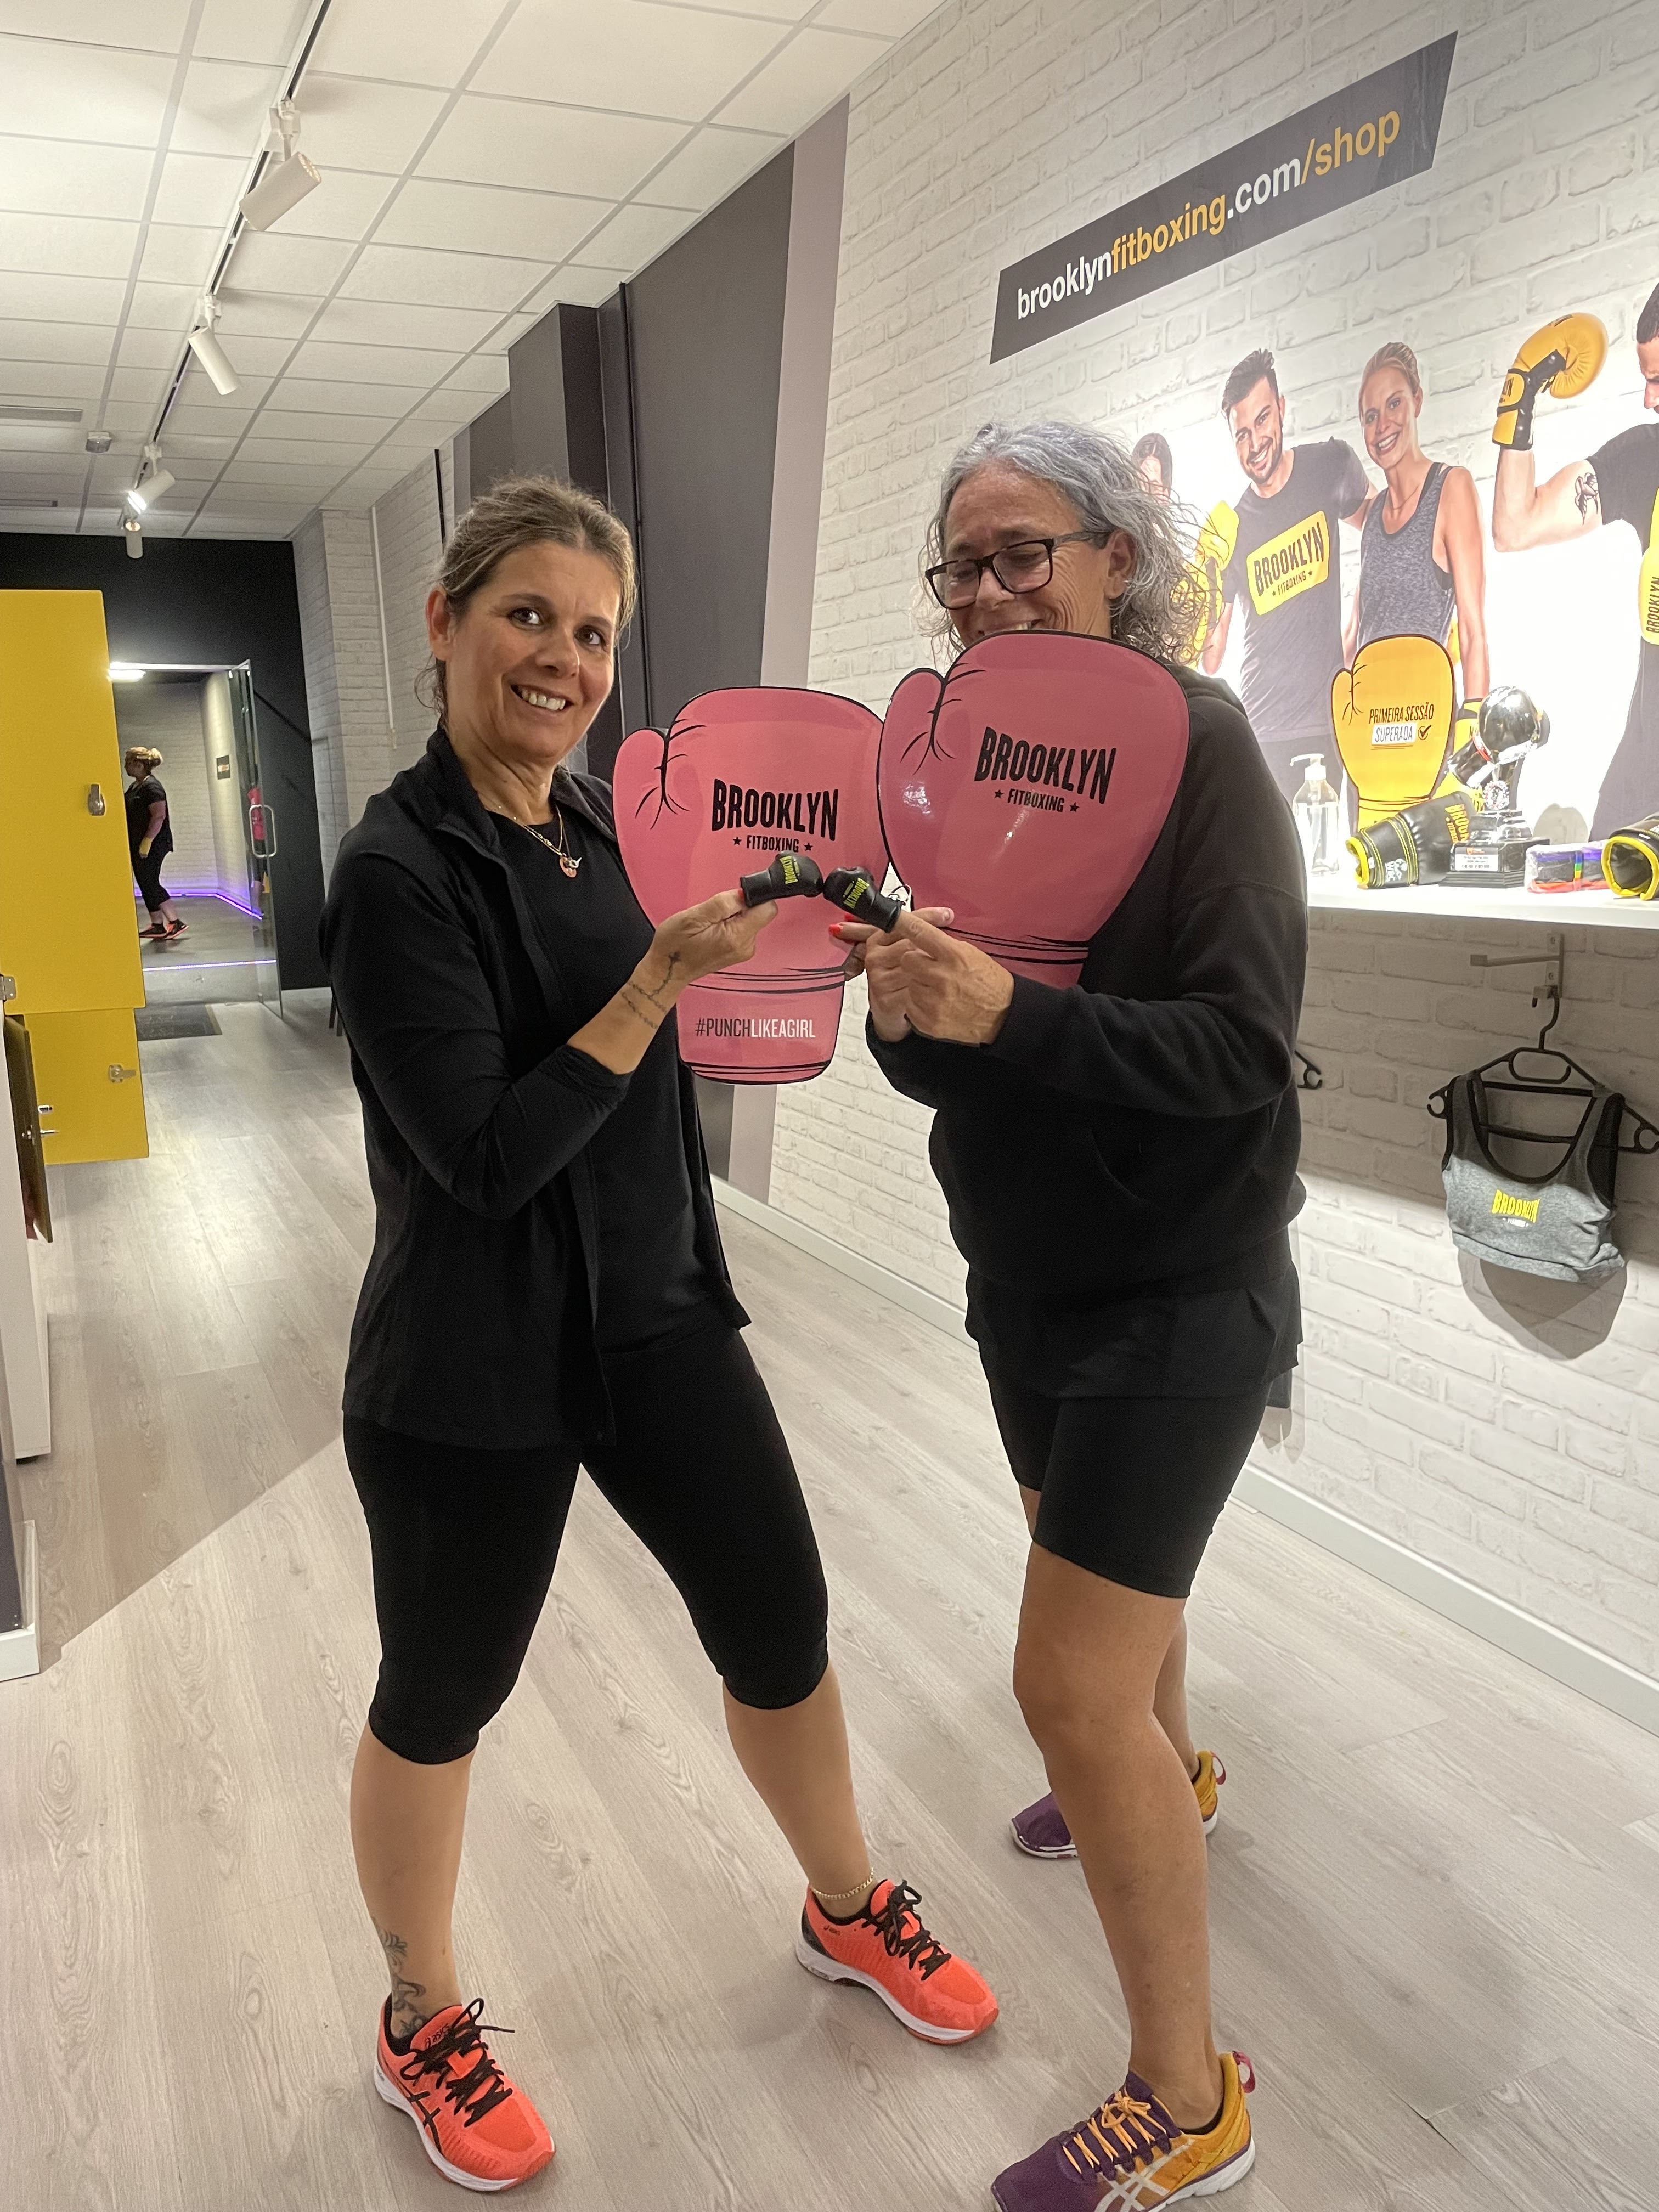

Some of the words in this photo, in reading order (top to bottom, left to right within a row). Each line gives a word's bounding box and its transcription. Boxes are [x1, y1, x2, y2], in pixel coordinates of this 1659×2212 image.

[1017, 111, 1400, 320] brooklynfitboxing.com/shop
[1253, 522, 1324, 597] BROOKLYN
[1277, 570, 1307, 595] FITBOXING
[1369, 706, 1403, 724] PRIMEIRA
[1404, 702, 1435, 721] SESSÃO
[1375, 725, 1413, 743] SUPERADA
[974, 726, 1117, 805] BROOKLYN
[712, 778, 839, 842] BROOKLYN
[1007, 788, 1065, 812] FITBOXING
[746, 834, 799, 853] FITBOXING
[843, 877, 870, 910] BROOKLYN
[695, 1017, 816, 1038] #PUNCHLIKEAGIRL
